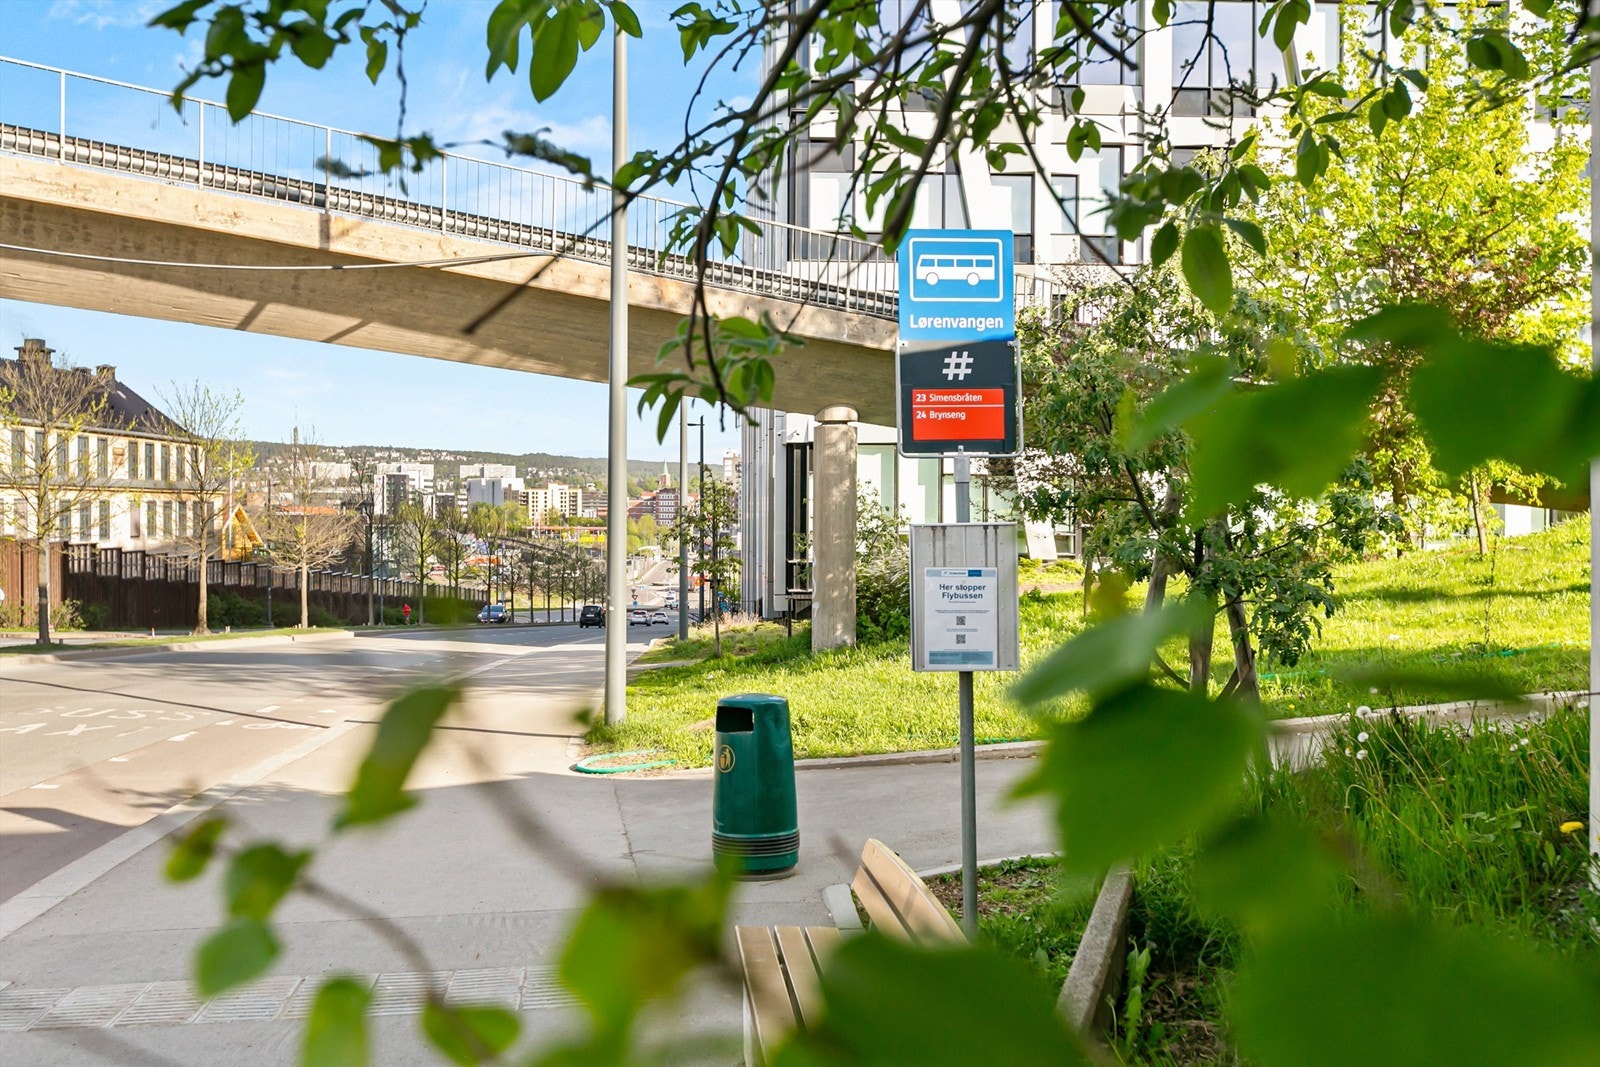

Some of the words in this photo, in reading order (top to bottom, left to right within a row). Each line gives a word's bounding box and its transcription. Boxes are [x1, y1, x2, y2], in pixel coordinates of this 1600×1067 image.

[909, 314, 1004, 331] Lørenvangen
[916, 393, 927, 402] 23
[929, 392, 983, 403] Simensbråten
[916, 410, 927, 419] 24
[929, 410, 966, 420] Brynseng
[939, 583, 953, 591] Her
[955, 583, 986, 593] stopper
[941, 591, 983, 600] Flybussen
